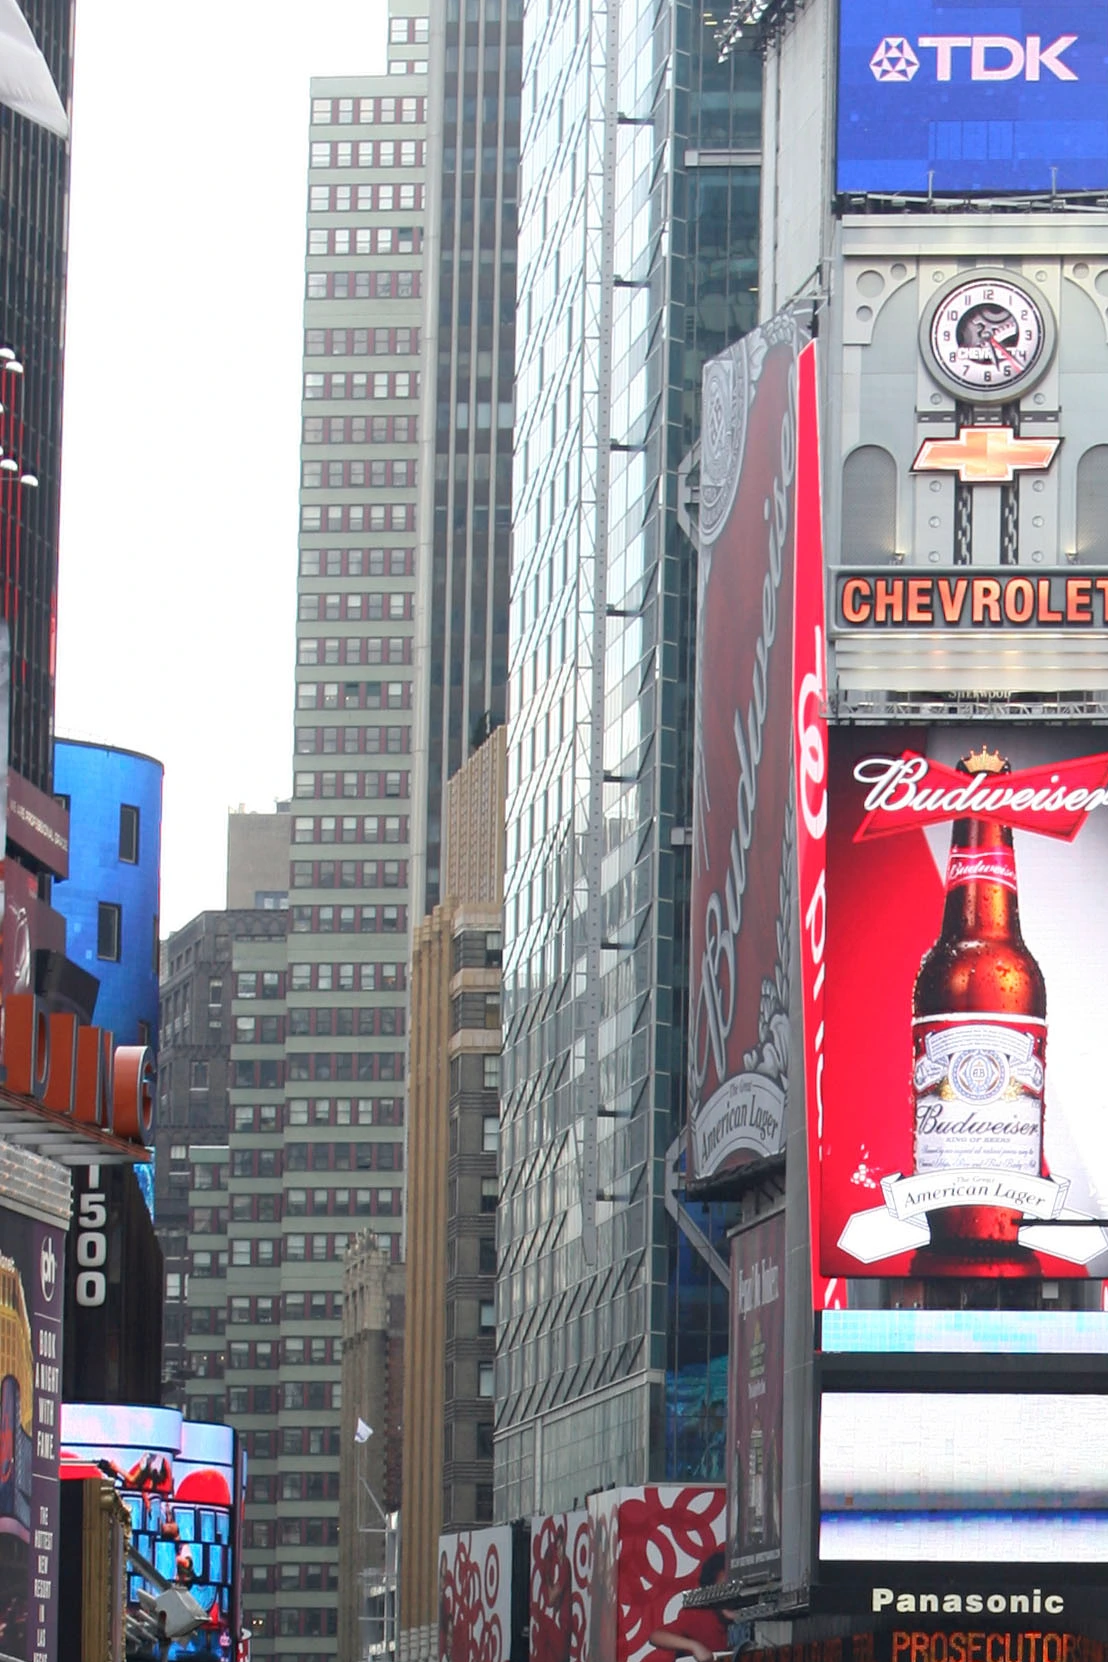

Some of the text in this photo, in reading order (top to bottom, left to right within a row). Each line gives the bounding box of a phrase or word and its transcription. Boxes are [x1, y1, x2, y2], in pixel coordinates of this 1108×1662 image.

[918, 34, 1079, 81] TDK
[702, 1095, 778, 1168] American Lager
[916, 1103, 1038, 1135] Budweiser
[905, 1182, 1045, 1208] American Lager
[39, 1330, 56, 1359] BOOK
[38, 1397, 54, 1426] WITH
[872, 1588, 1064, 1613] Panasonic
